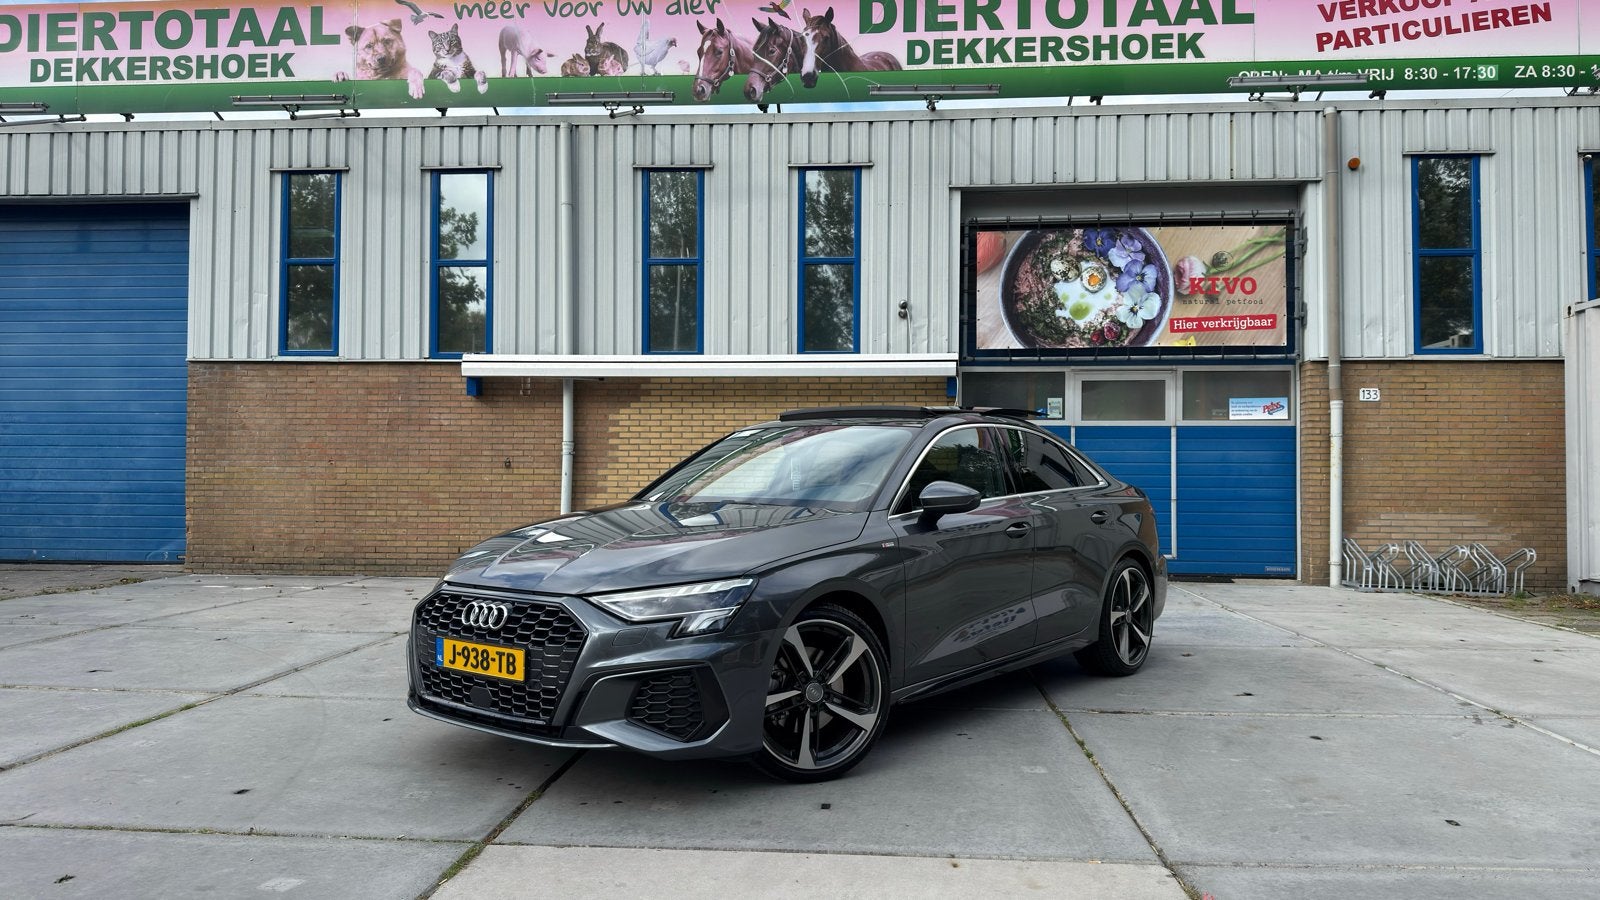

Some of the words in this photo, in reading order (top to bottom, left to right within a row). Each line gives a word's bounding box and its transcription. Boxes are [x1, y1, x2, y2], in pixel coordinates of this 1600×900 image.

[454, 0, 530, 19] meer
[0, 6, 341, 52] DIERTOTAAL
[1315, 2, 1552, 52] PARTICULIEREN
[906, 32, 1205, 65] DEKKERSHOEK
[30, 53, 295, 83] DEKKERSHOEK
[1404, 67, 1438, 80] 8:30
[1453, 65, 1496, 79] 17:30
[1514, 65, 1537, 78] ZA
[1541, 64, 1575, 78] 8:30
[1188, 276, 1257, 295] KIVO
[1226, 298, 1264, 306] petfood
[1173, 319, 1198, 330] Hier
[1201, 316, 1273, 330] verkrijgbaar
[1361, 389, 1378, 400] 133
[448, 644, 516, 675] J-938-TB
